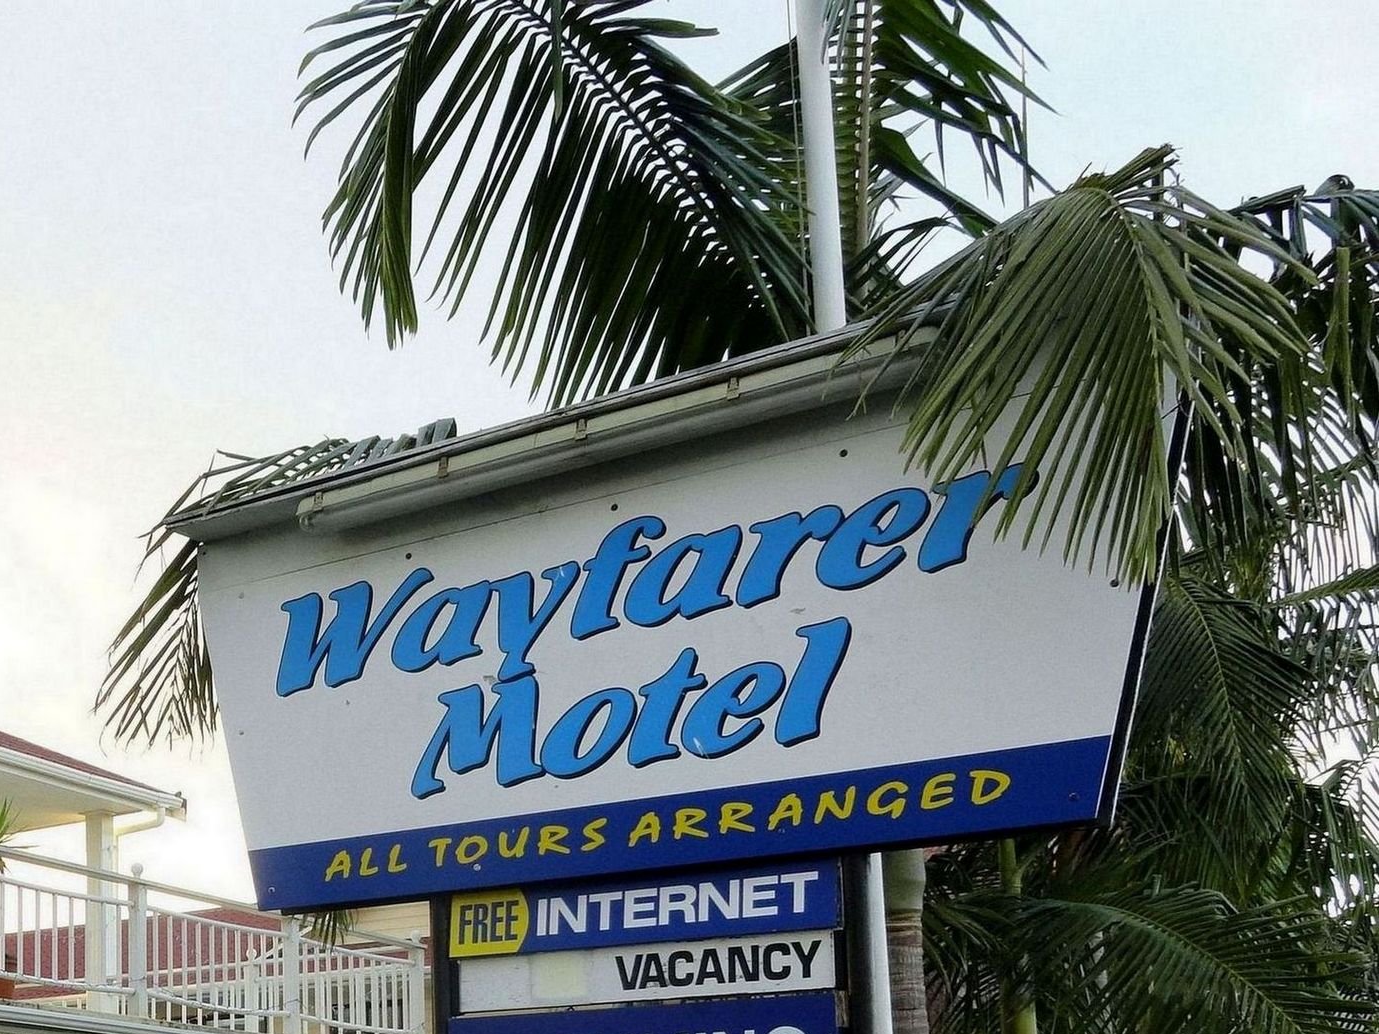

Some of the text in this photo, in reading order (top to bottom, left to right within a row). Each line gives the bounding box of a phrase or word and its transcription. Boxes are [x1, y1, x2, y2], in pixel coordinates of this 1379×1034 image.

[276, 462, 1038, 697] Wayfarer
[411, 617, 851, 799] Motel
[326, 769, 1011, 882] ALL TOURS ARRANGED
[458, 871, 819, 945] FREE INTERNET
[615, 940, 821, 991] VACANCY
